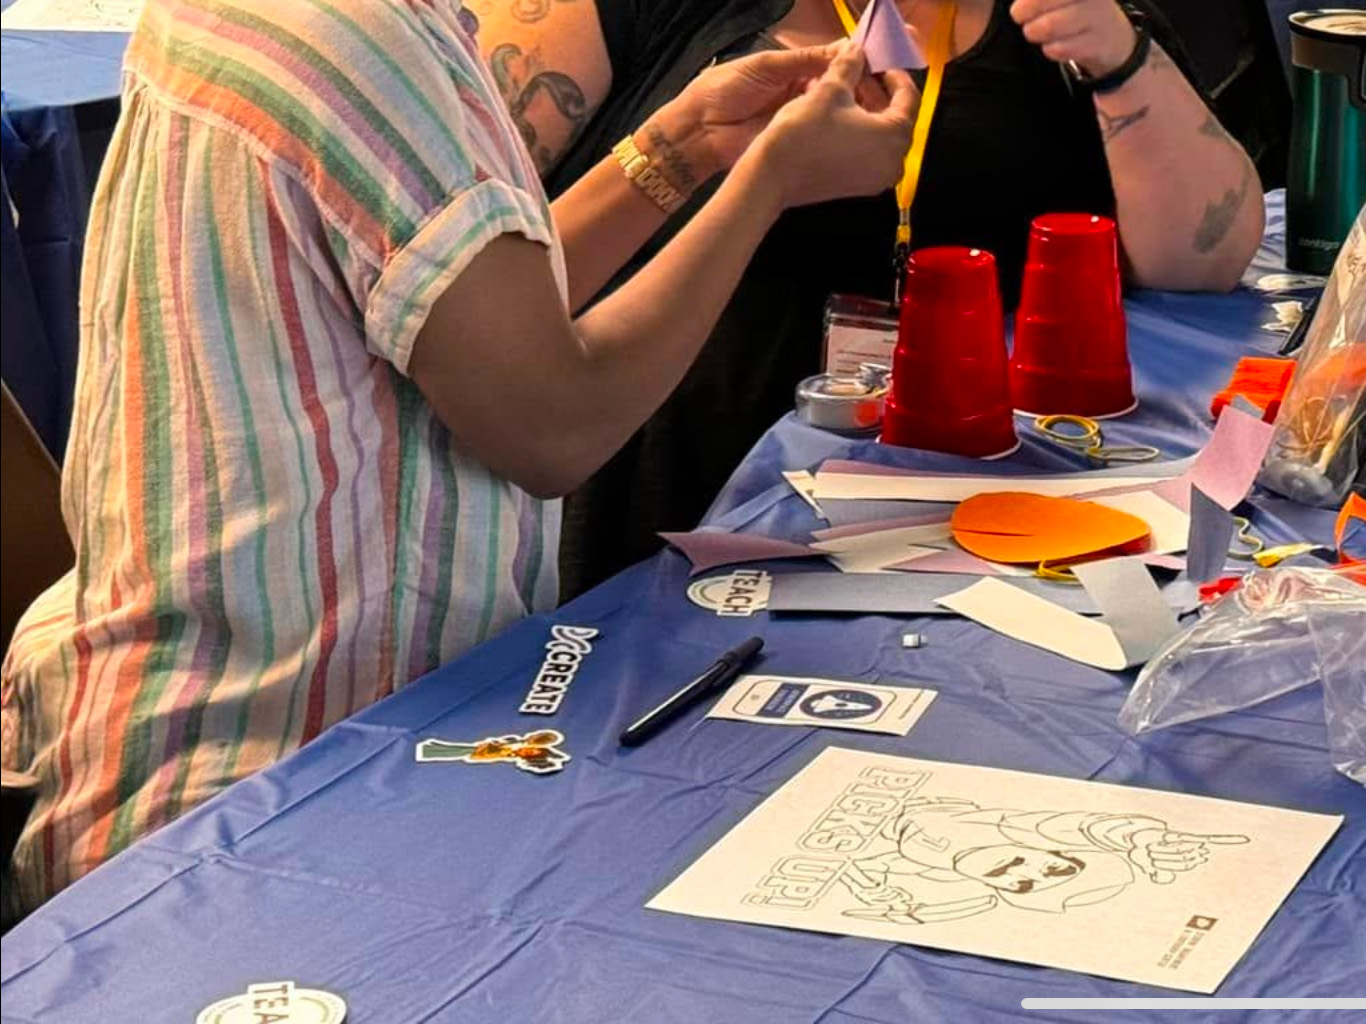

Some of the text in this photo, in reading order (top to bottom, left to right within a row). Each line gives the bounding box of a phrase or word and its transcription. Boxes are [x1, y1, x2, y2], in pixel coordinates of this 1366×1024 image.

[722, 571, 762, 614] TEACH
[797, 767, 932, 853] PICKS
[741, 855, 850, 910] UP!
